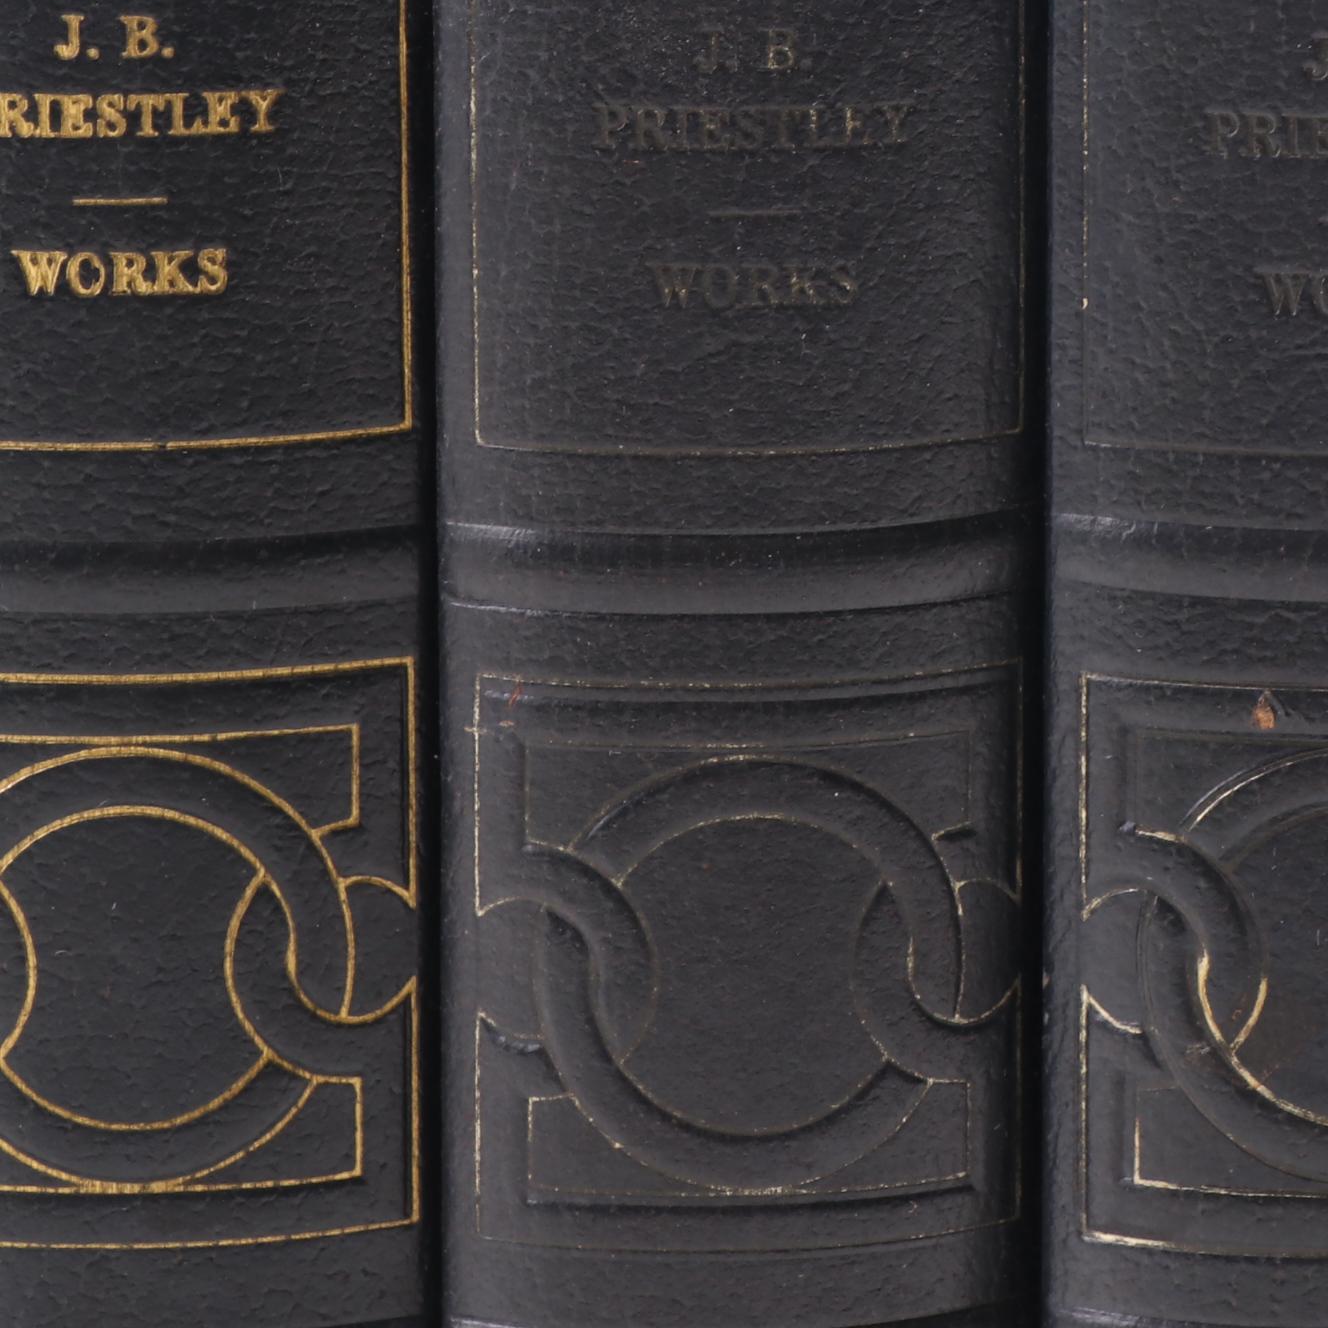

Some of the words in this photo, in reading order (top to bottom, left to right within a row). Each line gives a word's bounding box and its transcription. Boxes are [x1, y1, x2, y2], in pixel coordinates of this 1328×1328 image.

[54, 14, 99, 60] J.
[119, 14, 175, 60] B.
[592, 102, 914, 152] PRIESTLEY
[10, 248, 229, 298] WORKS
[646, 262, 858, 311] WORKS
